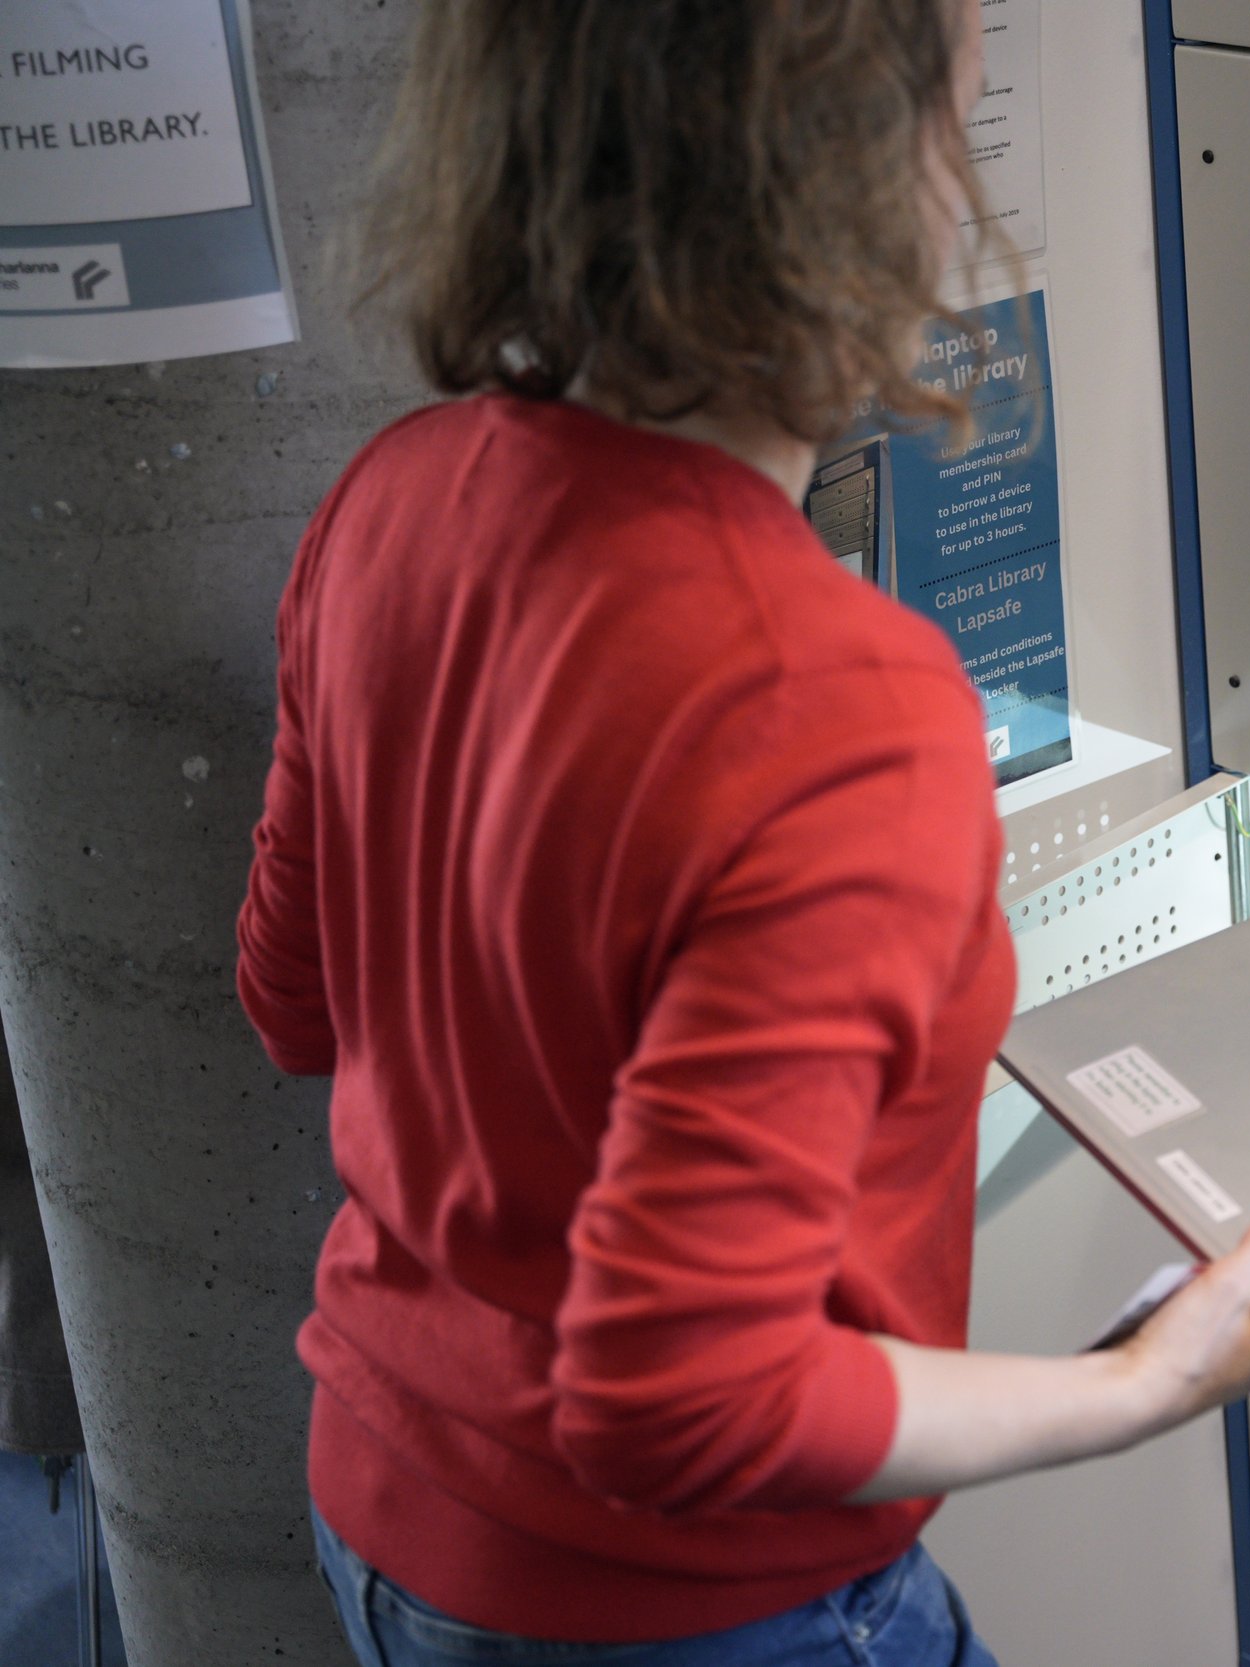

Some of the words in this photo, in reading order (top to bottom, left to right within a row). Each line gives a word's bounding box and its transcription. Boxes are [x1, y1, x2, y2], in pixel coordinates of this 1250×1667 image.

[12, 45, 148, 78] FILMING
[0, 125, 59, 149] THE
[69, 112, 209, 148] LIBRARY.
[923, 327, 998, 364] laptop
[917, 376, 946, 393] he
[953, 353, 1027, 390] library
[962, 438, 985, 455] your
[988, 427, 1020, 445] library
[940, 452, 1002, 478] membership
[1005, 443, 1027, 459] card
[962, 477, 981, 491] and
[984, 471, 1001, 485] PIN
[938, 508, 949, 518] to
[952, 496, 987, 514] borrow
[990, 494, 996, 503] a
[998, 483, 1031, 499] device
[936, 529, 947, 538] to
[949, 522, 967, 535] use
[969, 517, 978, 528] in
[981, 512, 998, 524] the
[1000, 501, 1033, 518] library
[941, 544, 956, 556] for
[958, 540, 971, 551] up
[974, 536, 984, 545] to
[987, 531, 993, 541] 3
[995, 523, 1026, 539] hours.
[935, 586, 985, 609] Cabra
[989, 562, 1046, 592] Library
[957, 599, 1021, 633] Lapsafe
[974, 666, 1006, 685] beside
[1008, 660, 1024, 673] the
[1027, 645, 1064, 666] Lapsafe
[980, 648, 998, 664] and
[1000, 632, 1053, 657] conditions
[986, 680, 1019, 700] Locker
